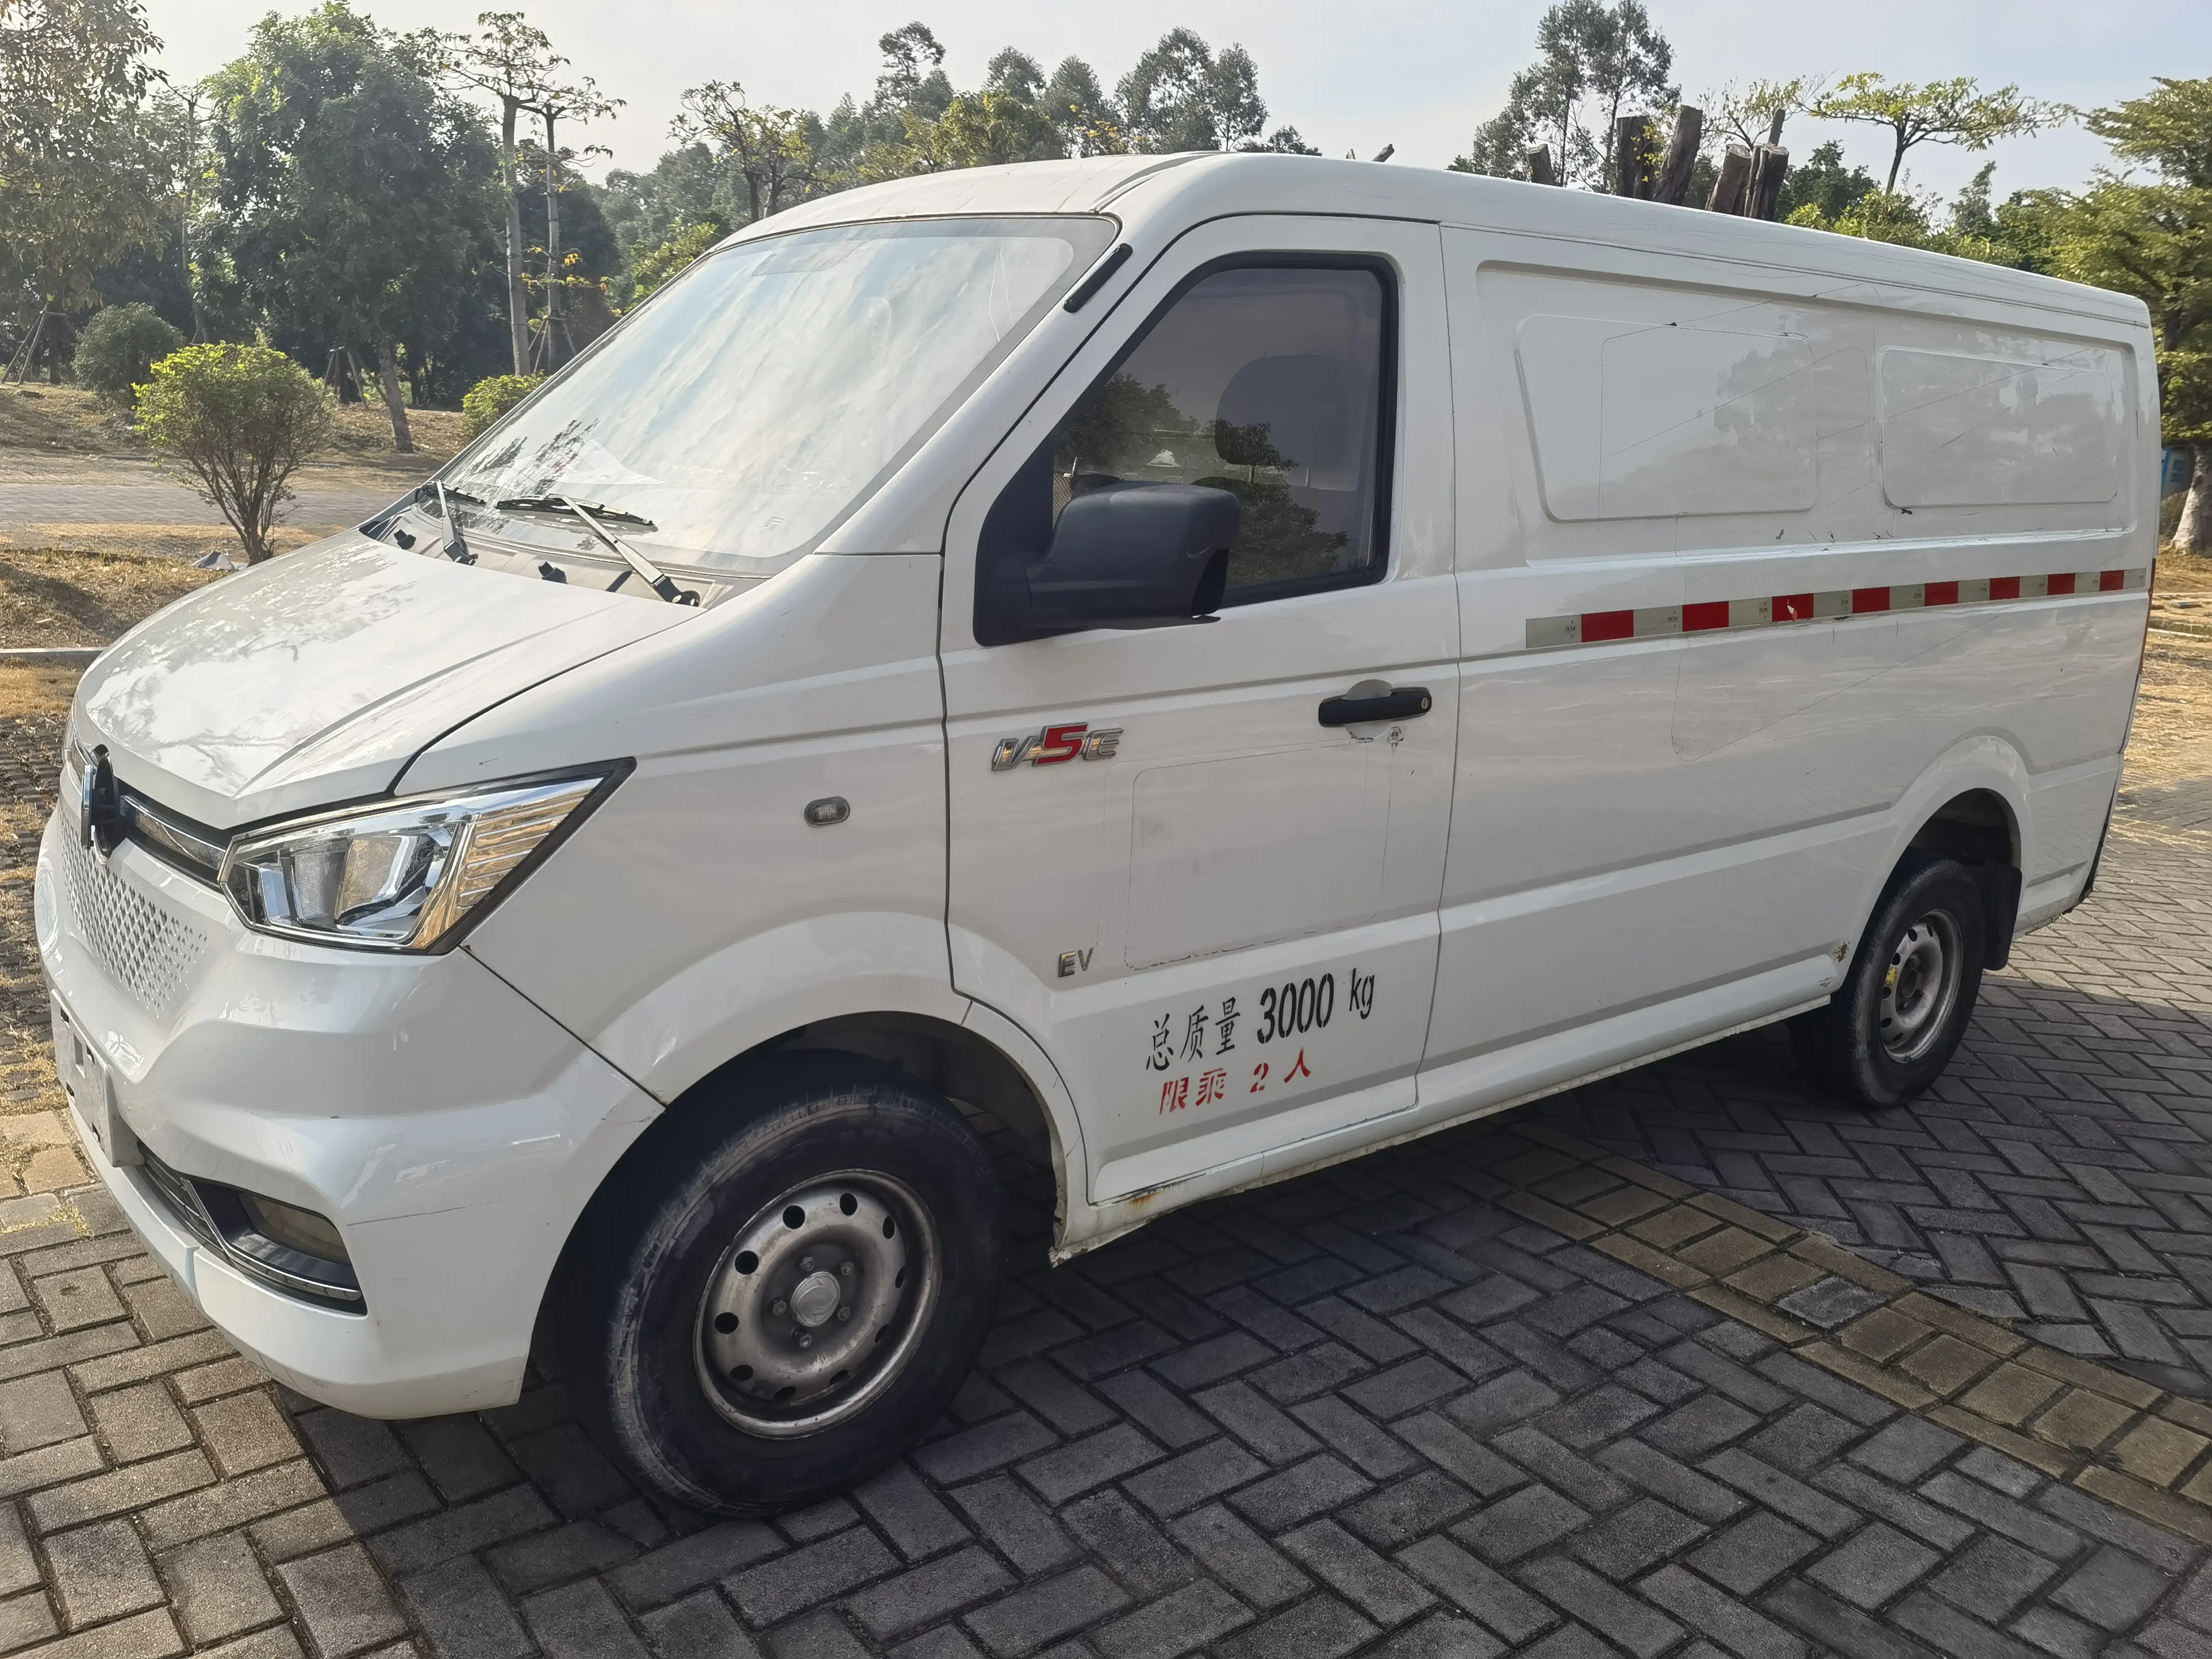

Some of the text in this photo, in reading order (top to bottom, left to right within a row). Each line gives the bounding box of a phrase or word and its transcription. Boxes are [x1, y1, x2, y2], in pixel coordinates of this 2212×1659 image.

[1058, 947, 1094, 978] EV
[1145, 968, 1375, 1071] 总质量 3000 kg
[1250, 1062, 1269, 1093] 2
[1283, 1048, 1311, 1084] 人
